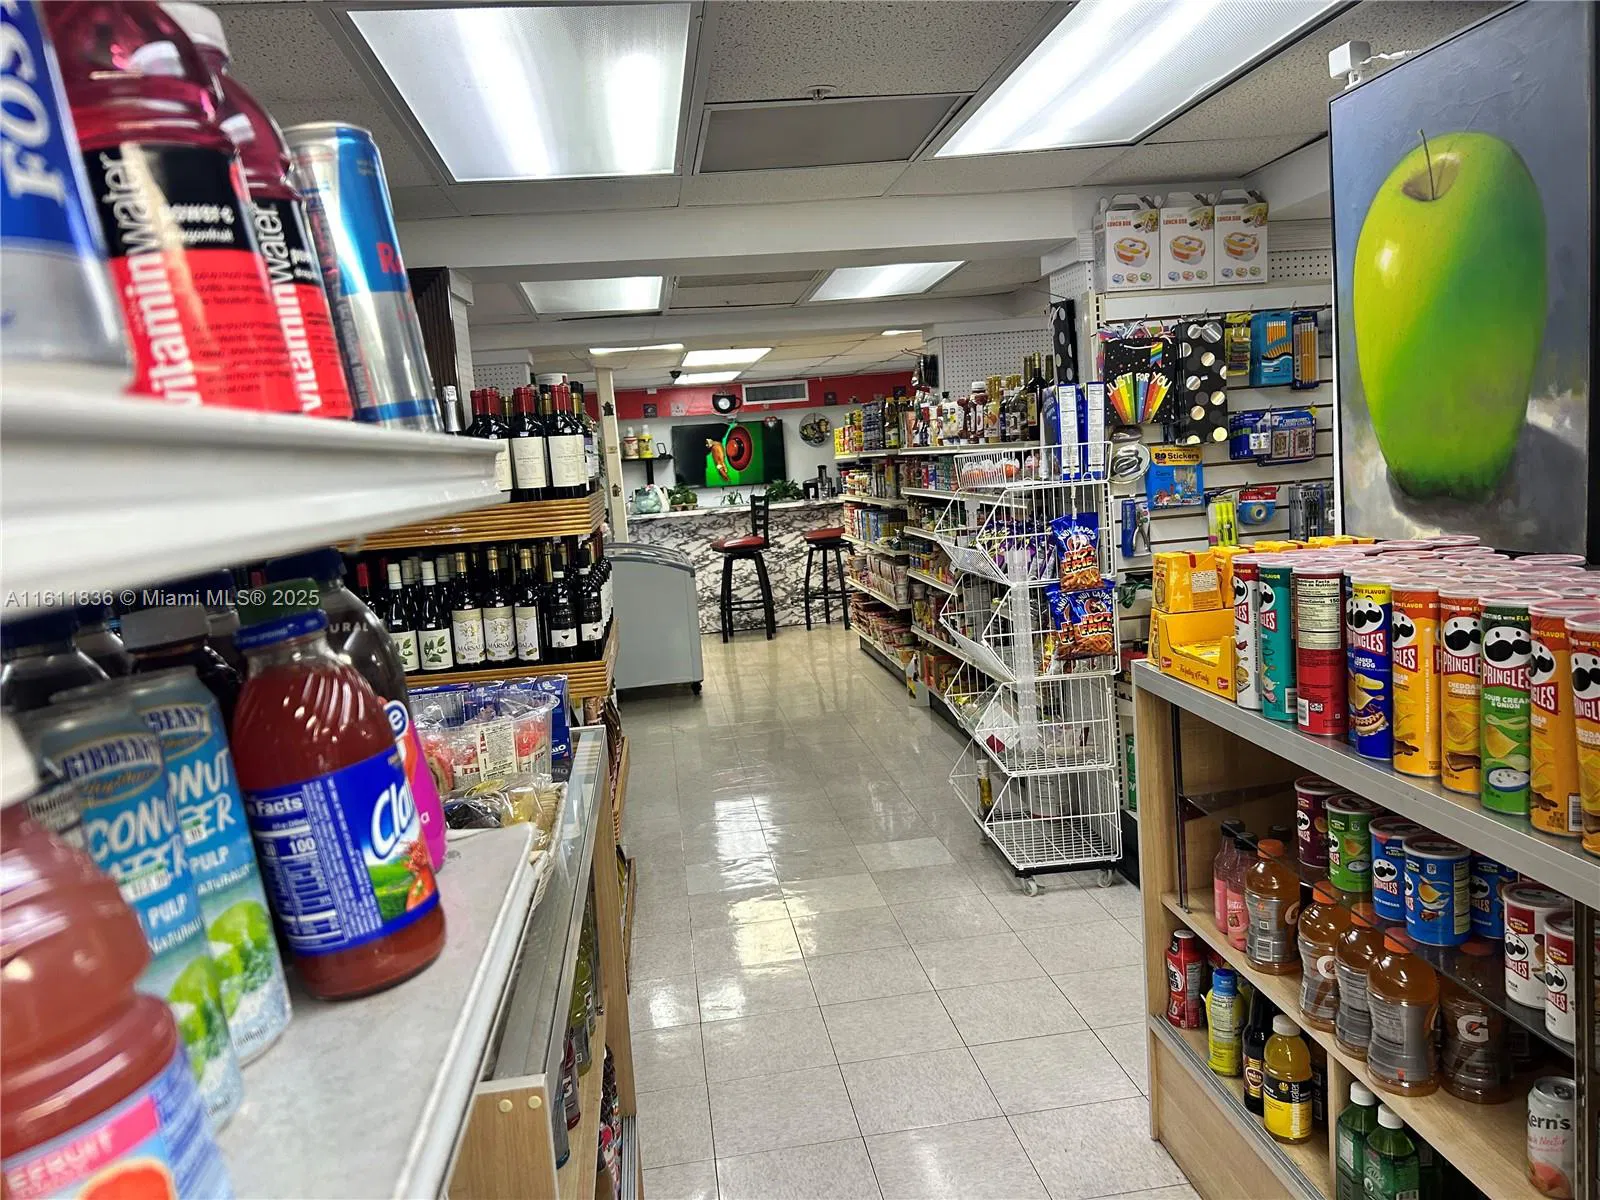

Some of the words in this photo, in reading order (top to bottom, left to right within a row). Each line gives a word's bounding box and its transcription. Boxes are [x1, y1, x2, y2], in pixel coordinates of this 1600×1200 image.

[250, 202, 323, 413] vitaminwater
[1106, 372, 1133, 397] JUST
[1135, 372, 1150, 383] FOR
[1150, 371, 1173, 390] YOU
[1154, 452, 1167, 460] 80
[1167, 452, 1200, 460] Stickers
[1081, 612, 1112, 625] HOT
[1540, 630, 1565, 639] FLAVOR
[1362, 660, 1376, 669] DOG
[1484, 693, 1501, 702] SOUR
[1496, 701, 1520, 709] ONION
[256, 797, 304, 816] Facts
[288, 837, 317, 856] 100
[189, 846, 229, 874] PULP
[147, 893, 188, 928] PULP
[1457, 1015, 1489, 1043] G
